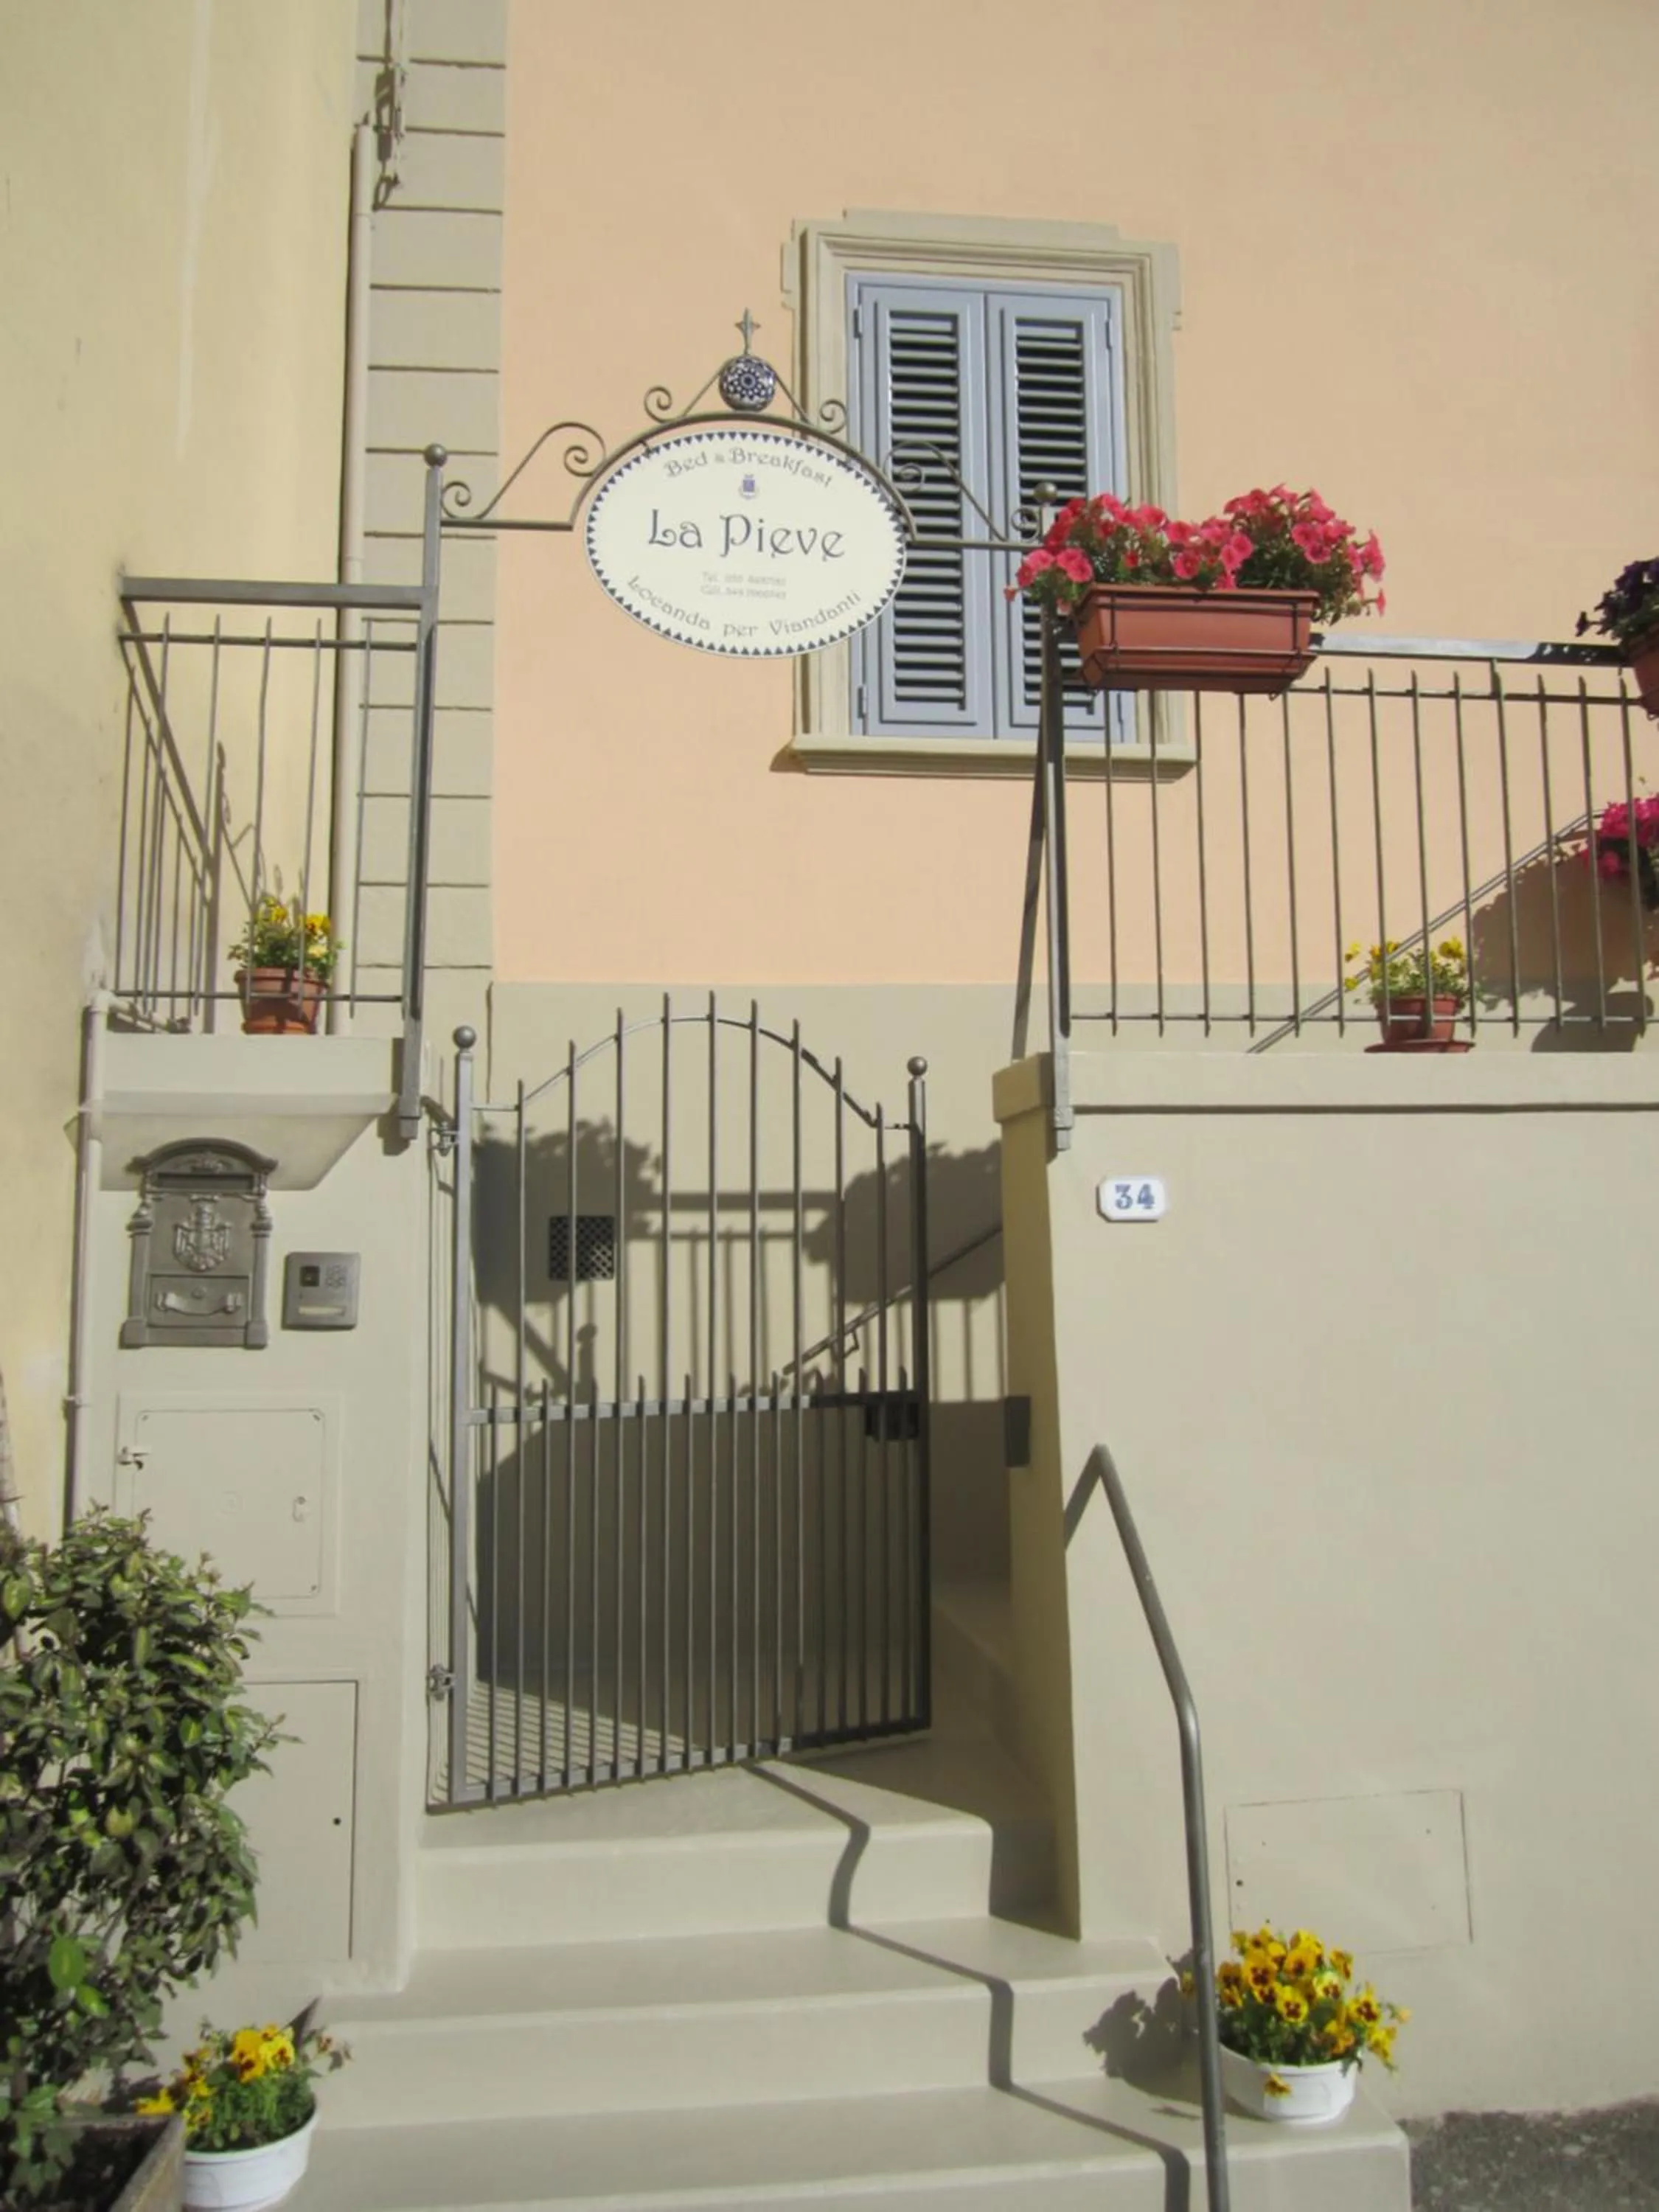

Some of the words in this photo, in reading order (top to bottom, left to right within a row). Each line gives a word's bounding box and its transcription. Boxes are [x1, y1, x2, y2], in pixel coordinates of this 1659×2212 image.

[664, 451, 708, 478] Bed
[728, 447, 833, 488] Breakfast
[647, 508, 703, 549] La
[719, 513, 846, 562] Pieve
[627, 574, 711, 631] Locanda
[723, 622, 759, 638] per
[769, 589, 861, 636] Viandanti
[1114, 1183, 1155, 1209] 34
